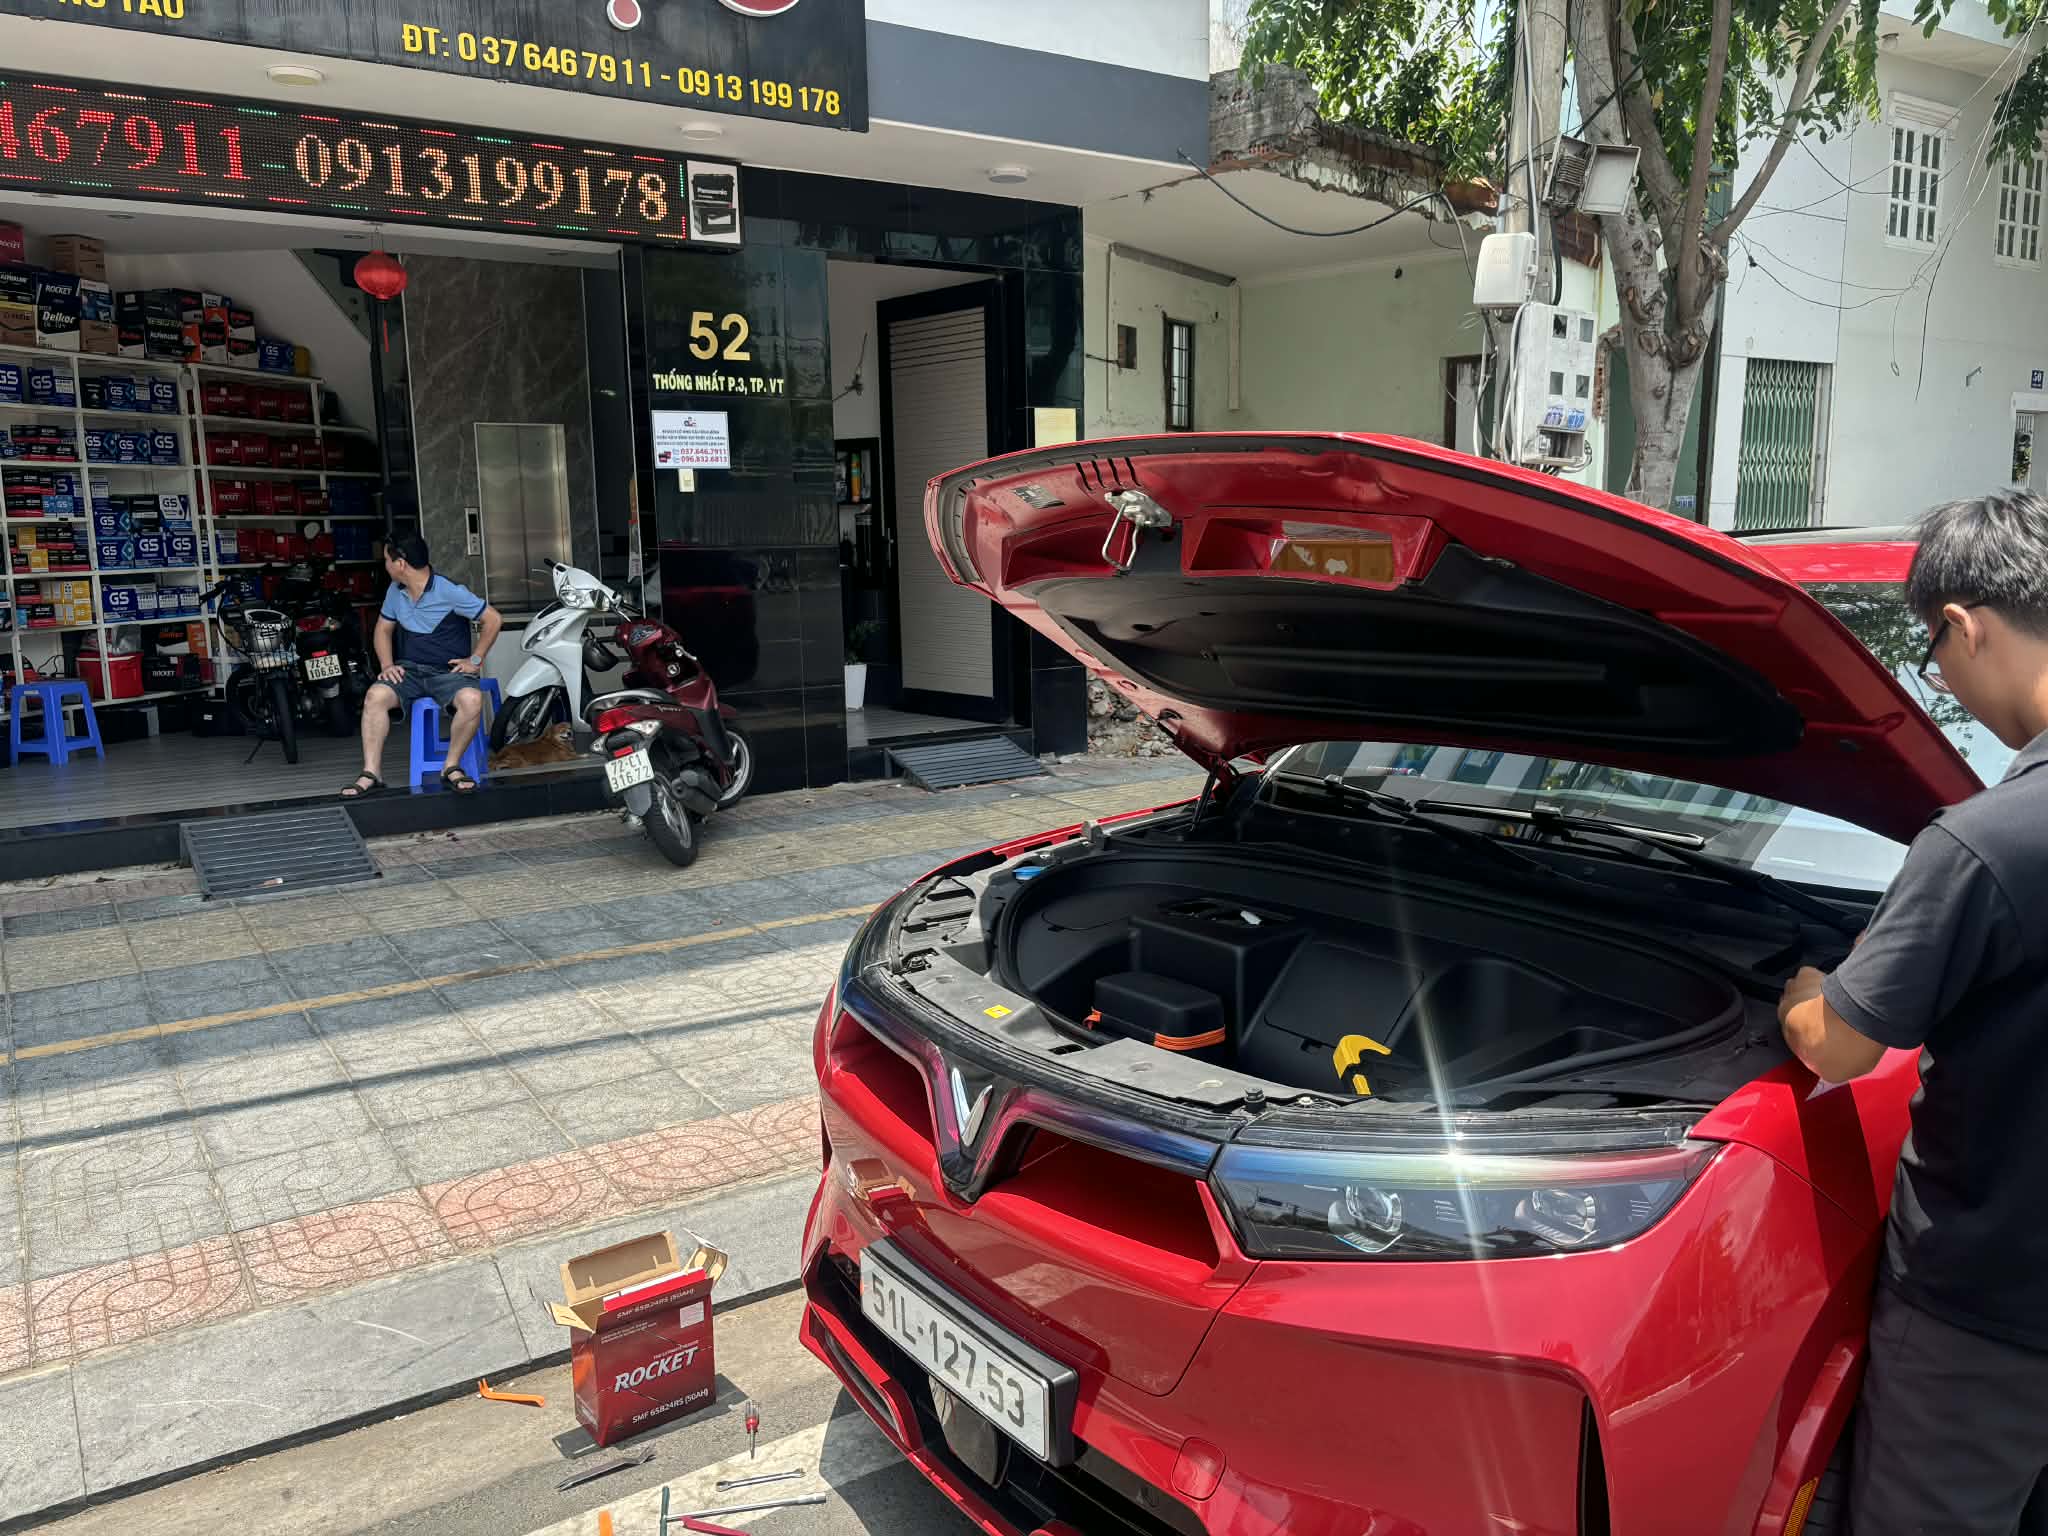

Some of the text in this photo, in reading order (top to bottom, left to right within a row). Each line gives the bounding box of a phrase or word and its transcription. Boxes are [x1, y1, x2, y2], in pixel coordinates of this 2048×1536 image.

[402, 24, 450, 57] ĐT:
[678, 67, 743, 101] 0913
[798, 86, 840, 115] 178
[296, 133, 667, 222] 0913199178
[45, 285, 73, 295] ROCKET
[43, 311, 76, 324] Delkor
[689, 311, 750, 361] 52
[266, 345, 279, 356] GS
[32, 376, 52, 389] GS
[653, 368, 692, 390] THỐNG
[695, 370, 725, 391] NHẤT
[750, 378, 767, 393] TP.
[769, 379, 784, 393] VT
[110, 386, 123, 396] GS
[154, 384, 173, 398] GS
[86, 435, 101, 447] GS
[119, 440, 135, 450] GS
[154, 435, 174, 449] GS
[162, 498, 178, 508] GS
[100, 516, 115, 526] GS
[102, 546, 118, 556] GS
[139, 538, 159, 552] GS
[172, 537, 192, 551] GS
[109, 591, 129, 605] GS
[611, 754, 641, 775] 72-C1
[612, 766, 651, 789] 316.72
[616, 1309, 632, 1319] SMF
[872, 1272, 1024, 1428] 51L-127.53
[614, 1346, 698, 1392] ROCKET
[632, 1411, 649, 1424] SMF
[684, 1388, 709, 1404] (50AH)
